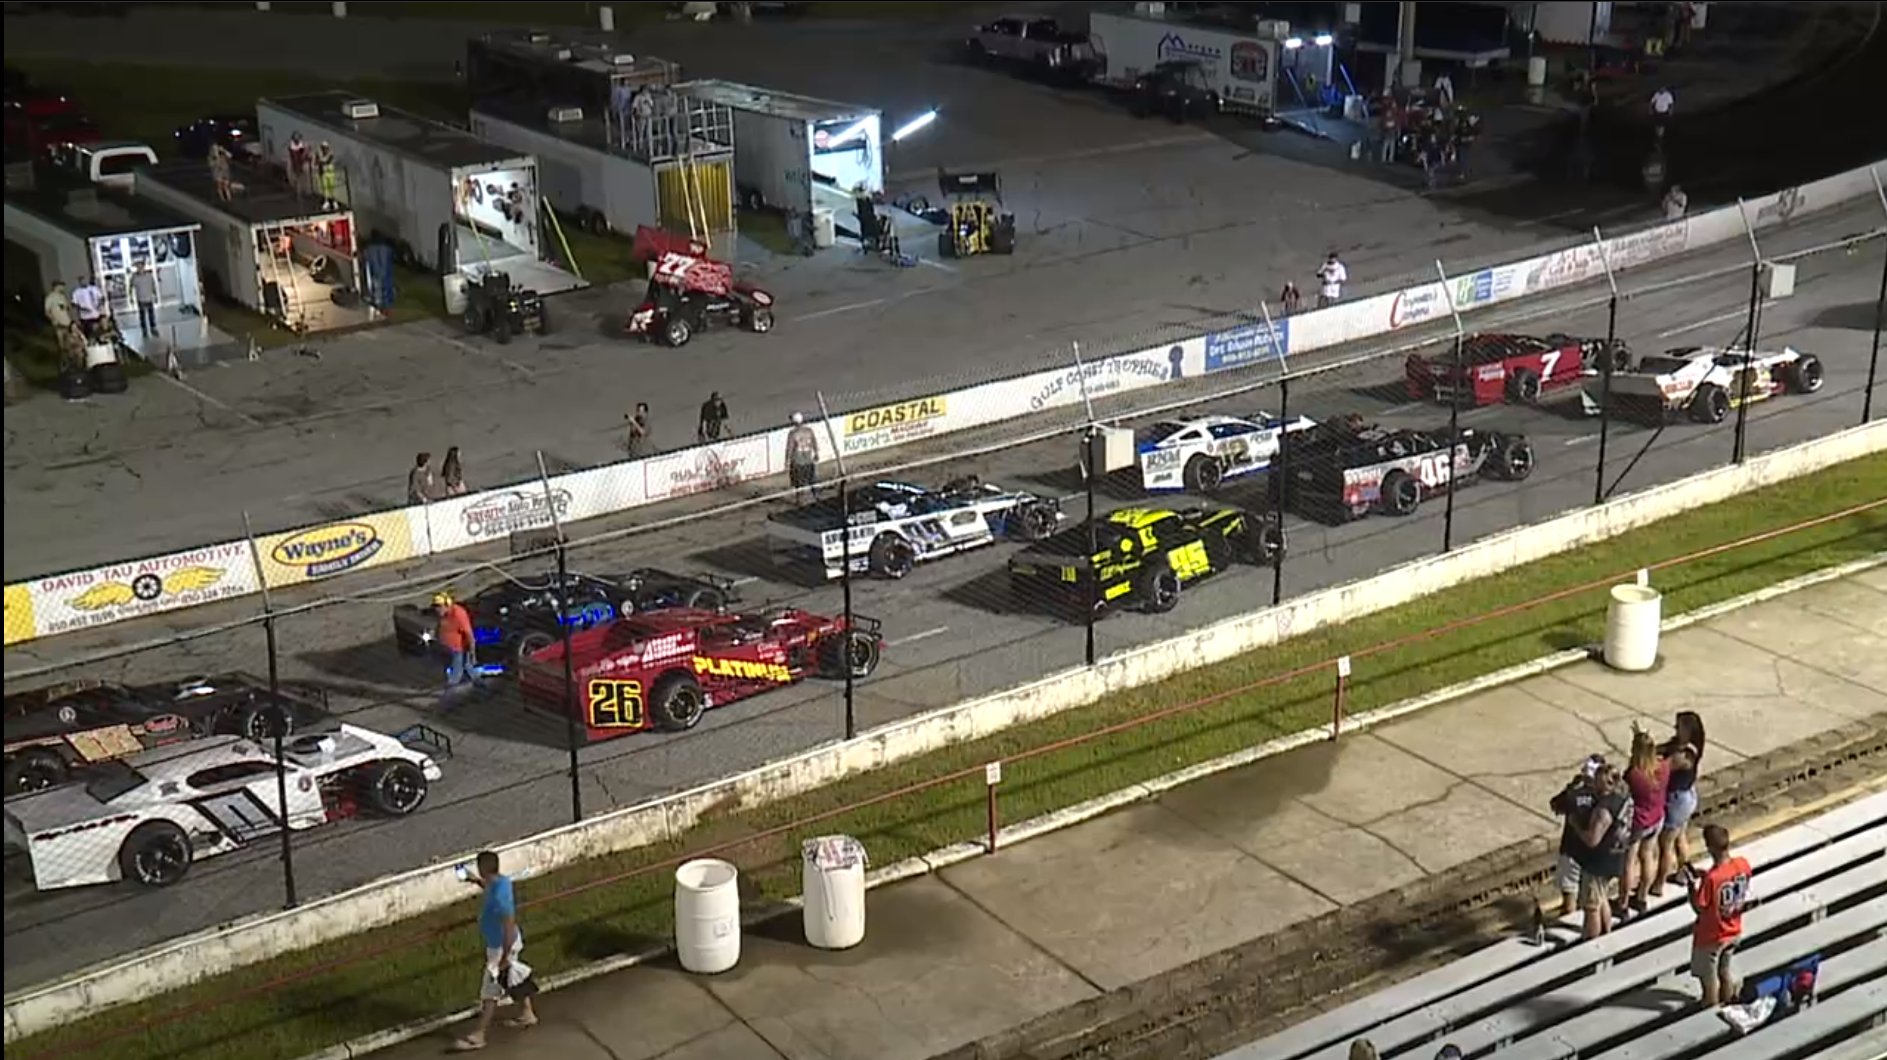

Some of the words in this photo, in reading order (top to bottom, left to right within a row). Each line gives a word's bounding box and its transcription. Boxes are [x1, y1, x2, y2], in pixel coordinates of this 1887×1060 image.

[1541, 350, 1561, 382] 7
[1030, 376, 1064, 411] GULF
[852, 400, 940, 432] COASTAL
[1420, 456, 1451, 488] 46
[282, 529, 368, 560] Wayne's
[41, 573, 94, 593] DAVID
[102, 565, 133, 581] TAU
[138, 544, 245, 574] AUTOMOTIVE
[588, 678, 644, 727] 26
